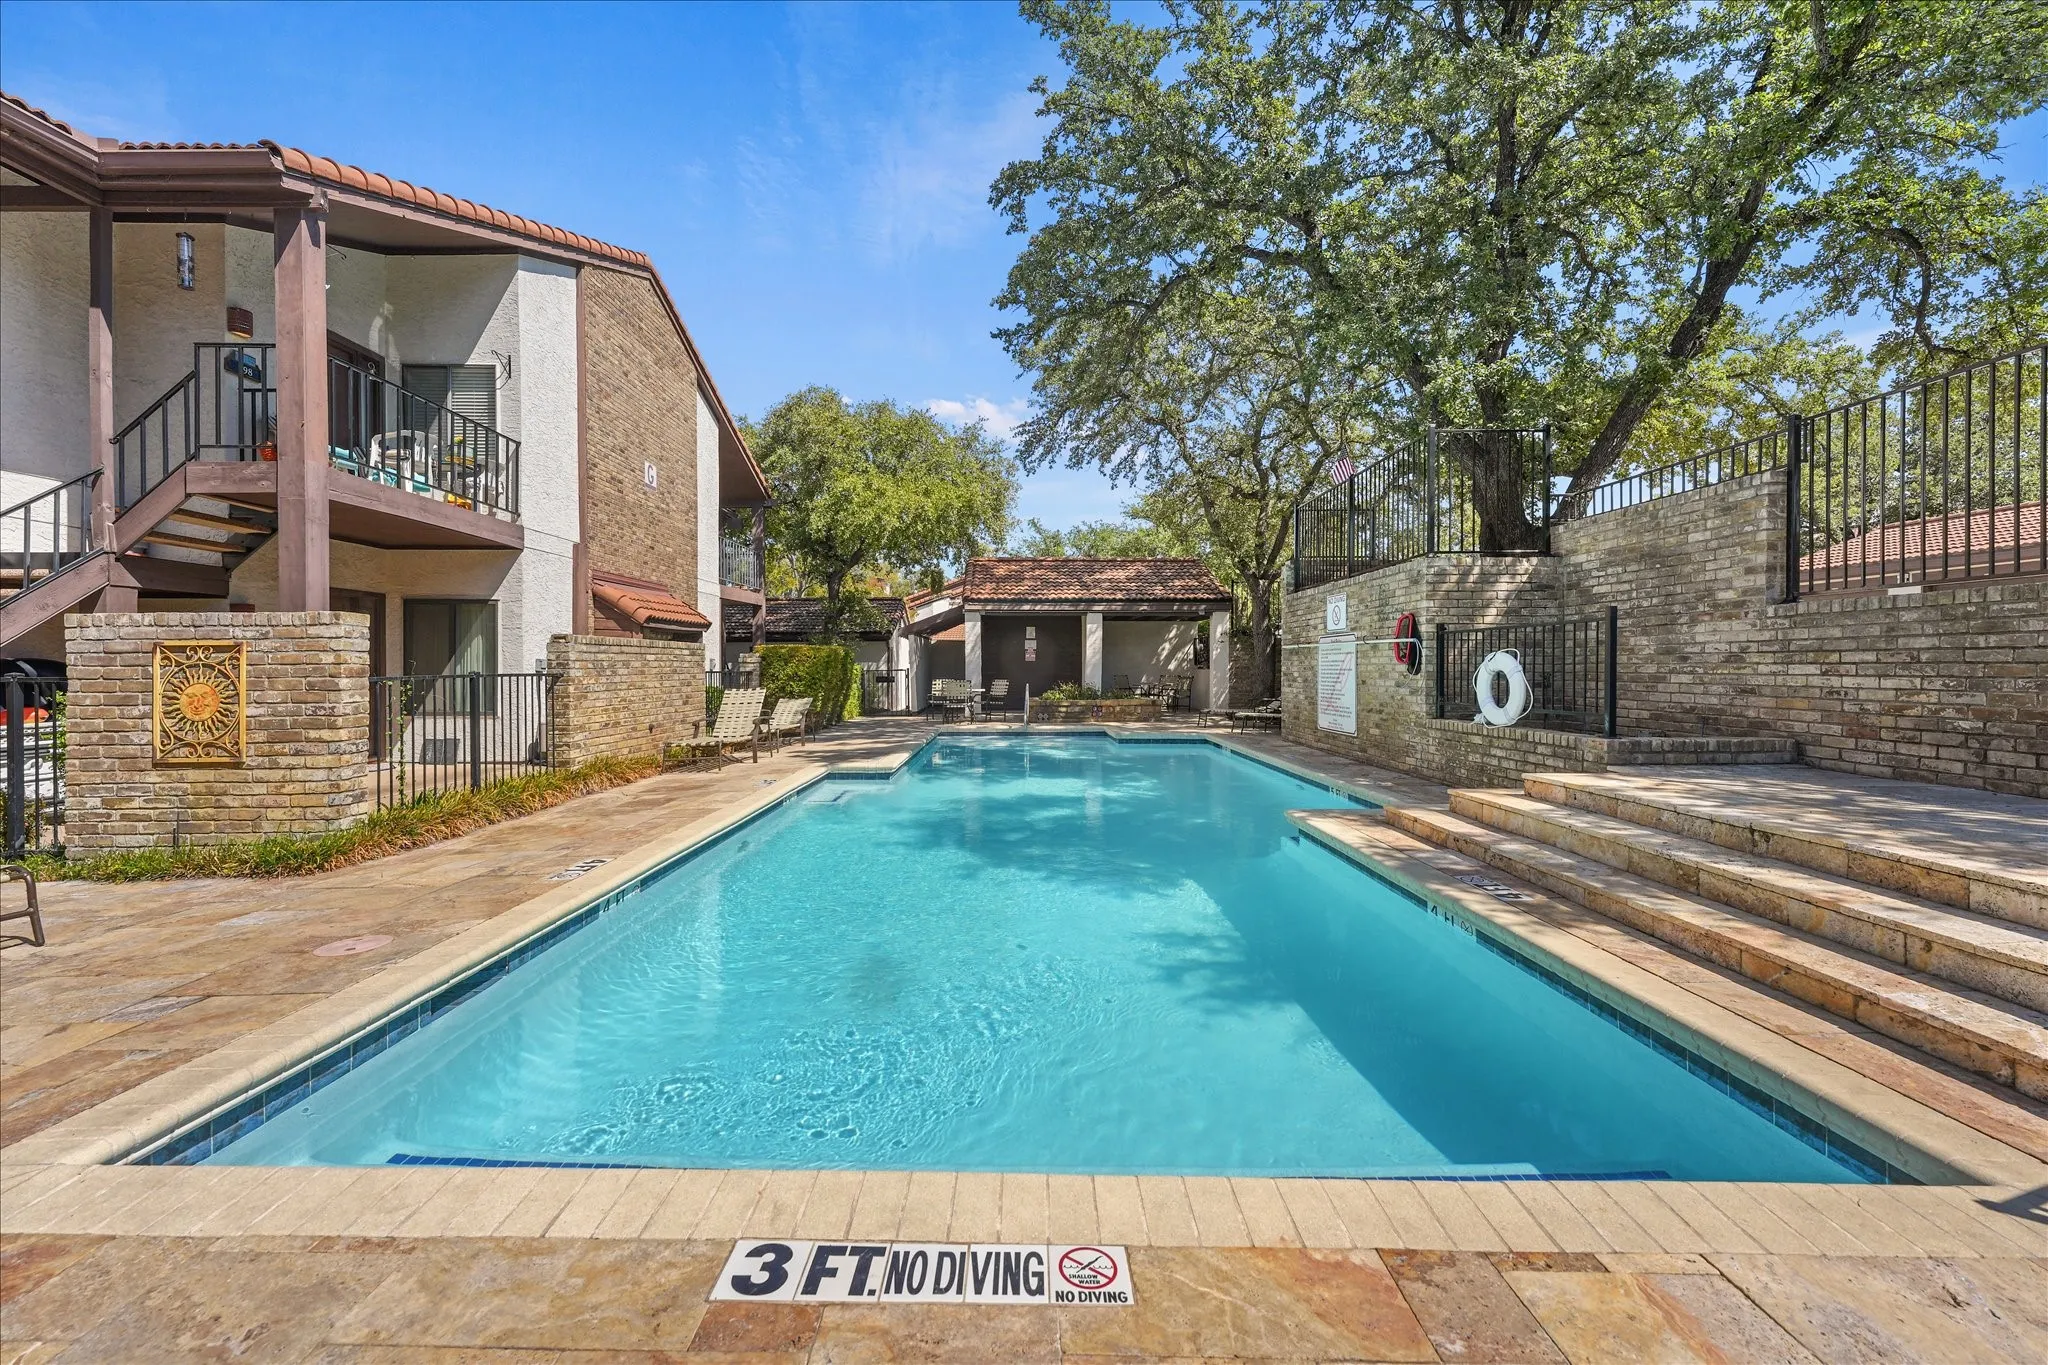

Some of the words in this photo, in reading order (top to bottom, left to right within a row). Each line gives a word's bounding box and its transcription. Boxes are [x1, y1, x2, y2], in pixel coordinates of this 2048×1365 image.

[647, 464, 655, 485] G
[731, 1243, 794, 1296] 3
[800, 1245, 887, 1296] FT.
[883, 1250, 929, 1296] NO
[932, 1251, 1045, 1297] DIVING
[1055, 1290, 1076, 1303] NO
[1078, 1291, 1128, 1304] DIVING
